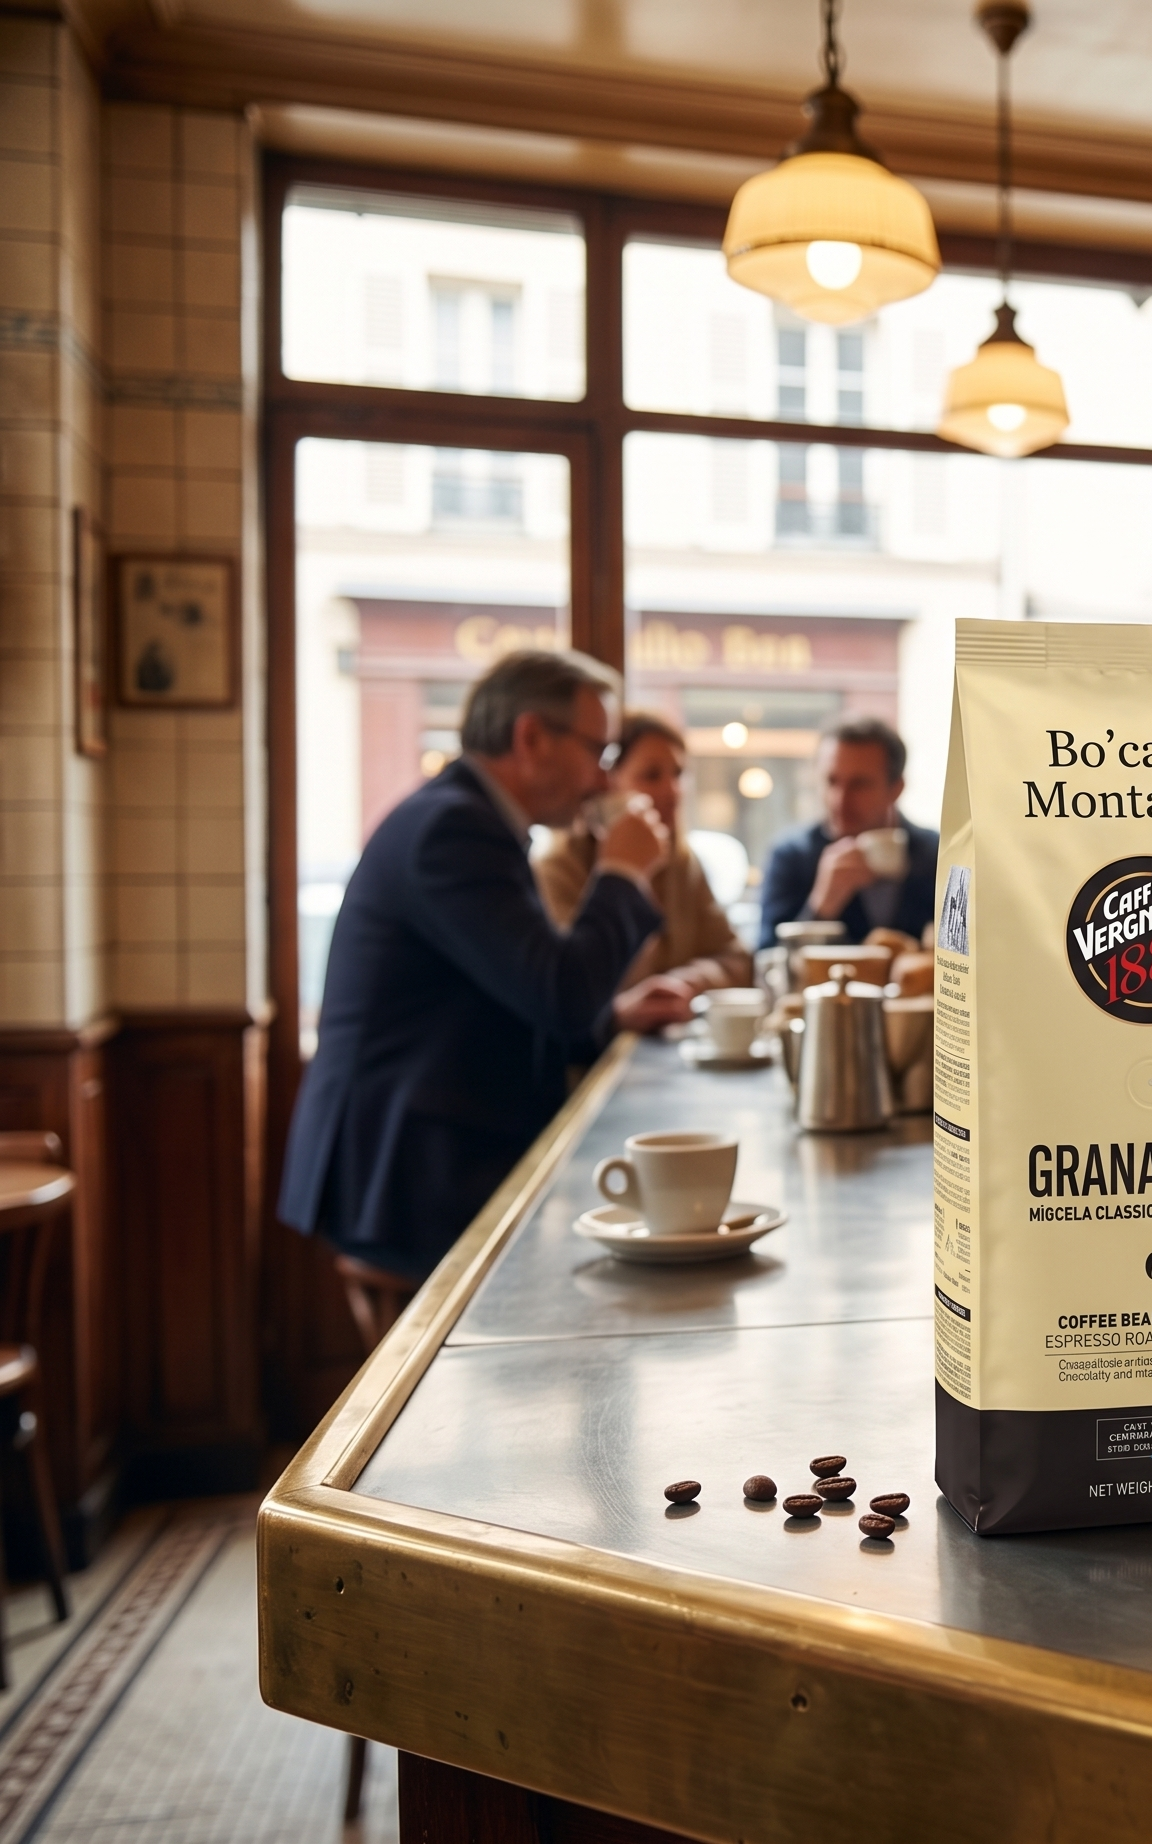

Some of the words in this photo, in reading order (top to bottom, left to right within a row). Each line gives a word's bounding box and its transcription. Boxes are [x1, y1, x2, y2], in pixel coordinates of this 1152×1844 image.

[1058, 1314, 1117, 1329] COFFEE
[1045, 1332, 1121, 1348] ESPRESSO
[1113, 1369, 1132, 1380] and
[1089, 1483, 1113, 1498] NET
